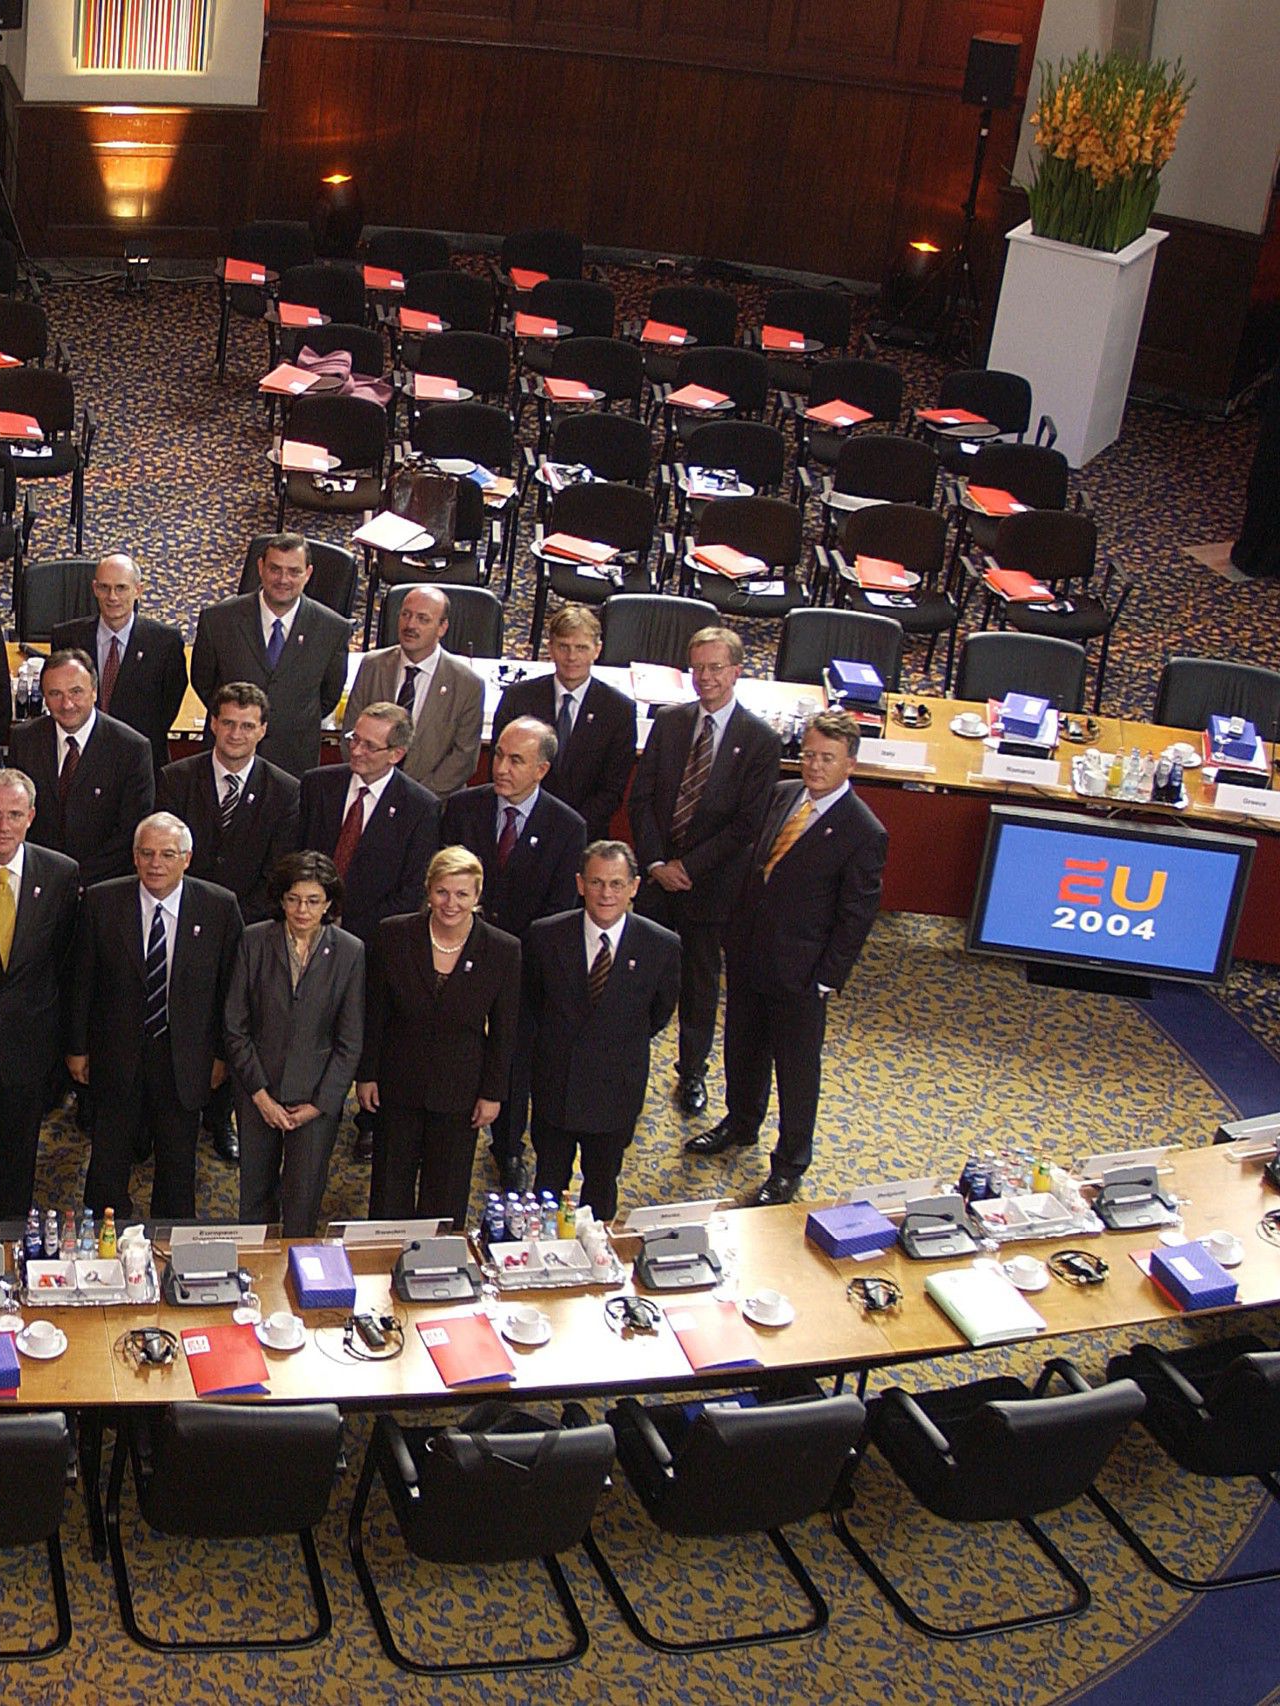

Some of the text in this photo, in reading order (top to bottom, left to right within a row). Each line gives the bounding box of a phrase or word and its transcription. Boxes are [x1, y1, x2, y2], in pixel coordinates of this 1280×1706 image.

[1243, 798, 1267, 806] Greece
[1058, 858, 1168, 911] EU
[1051, 907, 1156, 940] 2004
